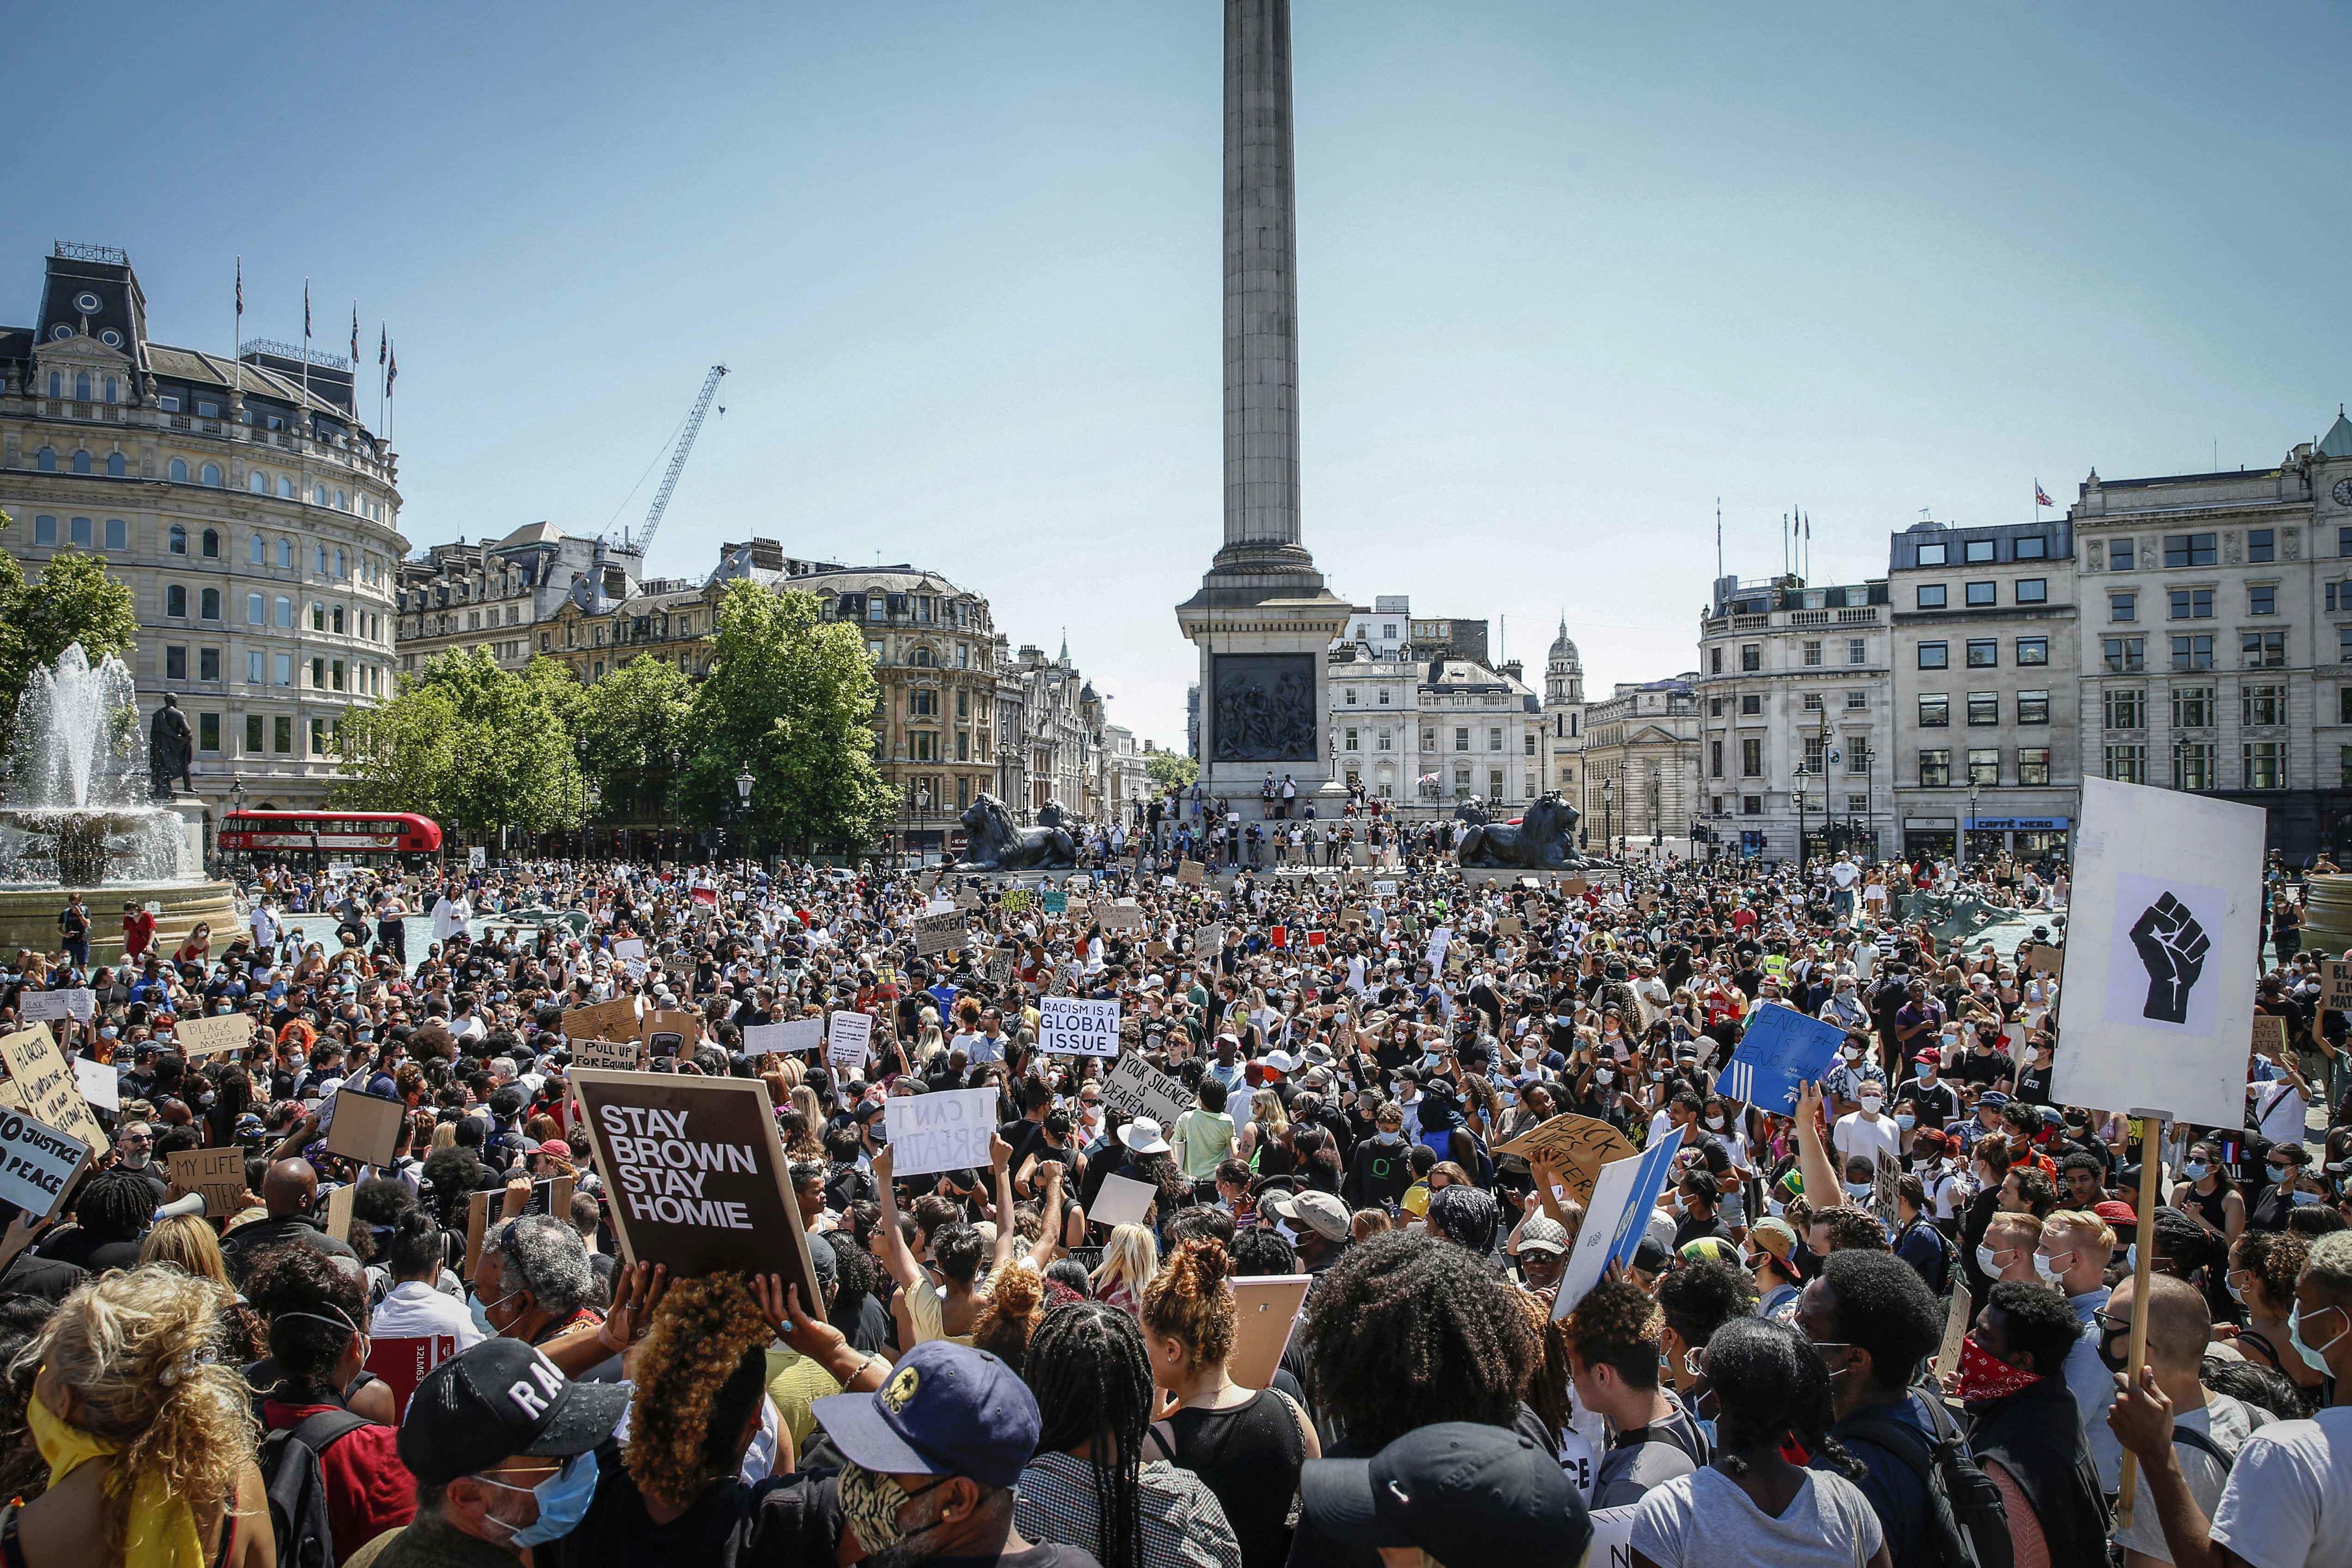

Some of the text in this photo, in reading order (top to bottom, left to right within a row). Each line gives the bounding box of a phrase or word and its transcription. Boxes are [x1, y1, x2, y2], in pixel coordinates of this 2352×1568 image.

[2108, 483, 2273, 505] CANADIAN PACIFIC
[1002, 889, 1029, 900] BLACK
[1374, 883, 1396, 894] ENOUGH
[1002, 903, 1029, 912] MATTER
[924, 916, 965, 932] INNOCENT
[1198, 929, 1215, 938] BLACK
[993, 949, 1001, 961] NO
[1199, 942, 1216, 952] MATTER
[629, 957, 642, 966] BLACK
[666, 955, 695, 965] ACAB
[993, 961, 1007, 972] BEING
[1044, 1002, 1114, 1017] RACISM IS A
[187, 1021, 231, 1035] BLACK
[1040, 1013, 1118, 1034] GLOBAL
[1760, 1008, 1837, 1047] ENOUGH
[2253, 1020, 2277, 1029] LACK
[200, 1035, 246, 1048] MATTER
[203, 1030, 232, 1040] LIVES
[1050, 1033, 1107, 1051] ISSUE
[1775, 1034, 1796, 1052] IS
[23, 1037, 48, 1062] RACISTS
[585, 1042, 632, 1058] PULL UP
[2252, 1040, 2284, 1050] ATTER
[576, 1055, 599, 1067] FOR
[49, 1069, 62, 1086] THE
[1121, 1053, 1191, 1108] YOUR SILENCE
[1136, 1084, 1148, 1097] IS
[56, 1092, 68, 1109] AND
[66, 1102, 83, 1126] COME
[601, 1104, 689, 1139] STAY
[22, 1126, 82, 1156] JUSTICE
[1524, 1132, 1583, 1152] LIVES
[1544, 1115, 1621, 1159] BLACK
[609, 1135, 758, 1174] BROWN
[1879, 1151, 1892, 1175] NO
[176, 1155, 240, 1176] MY LIFE
[6, 1156, 64, 1196] PEACE
[619, 1165, 706, 1198] STAY
[1882, 1186, 1892, 1205] NO
[628, 1193, 753, 1229] HOMIE
[1875, 1197, 1895, 1227] PEACE
[416, 1345, 424, 1381] 32LM63
